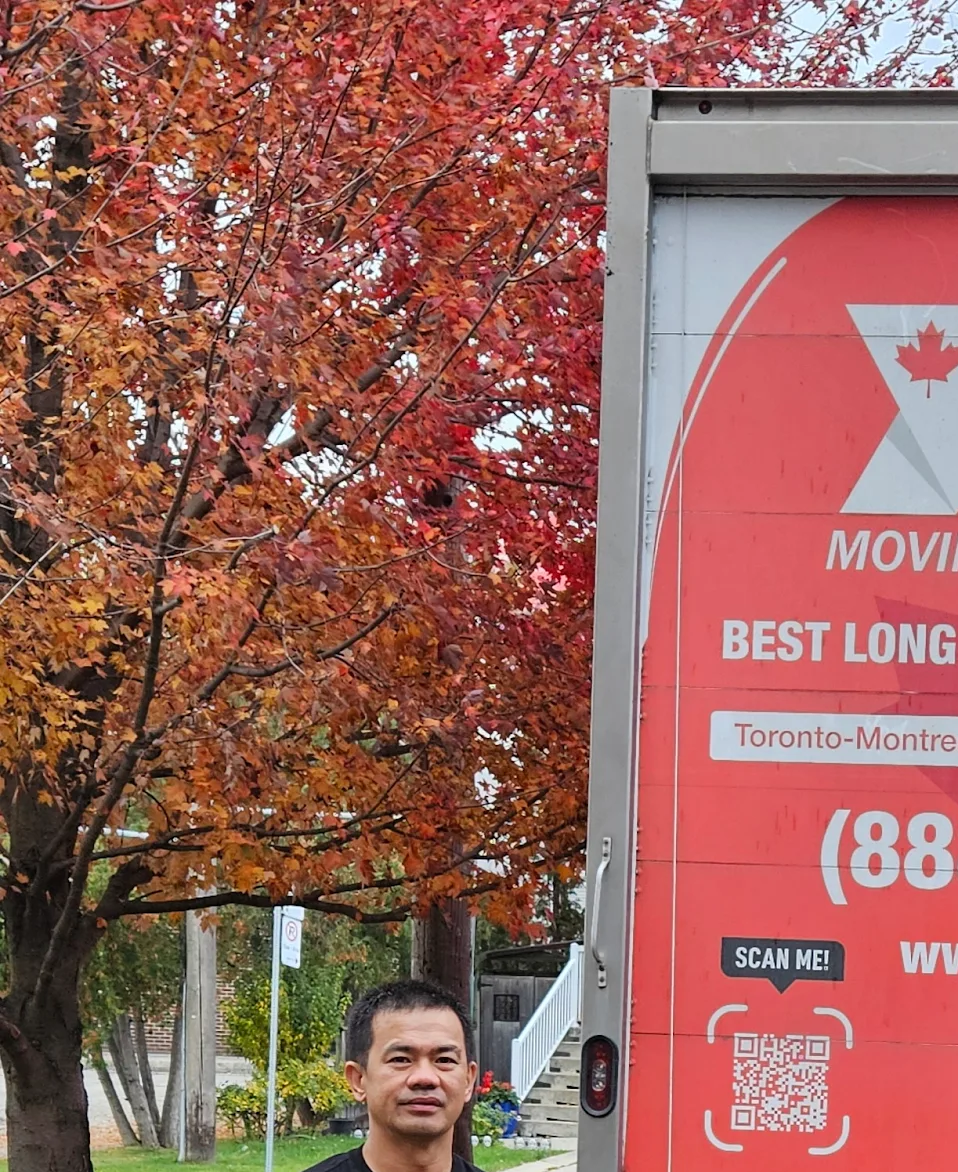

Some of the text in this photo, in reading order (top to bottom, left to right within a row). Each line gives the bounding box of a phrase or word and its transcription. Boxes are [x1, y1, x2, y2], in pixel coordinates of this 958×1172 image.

[721, 619, 831, 662] BEST
[843, 621, 957, 665] LONG
[735, 946, 831, 972] SCAN ME!
